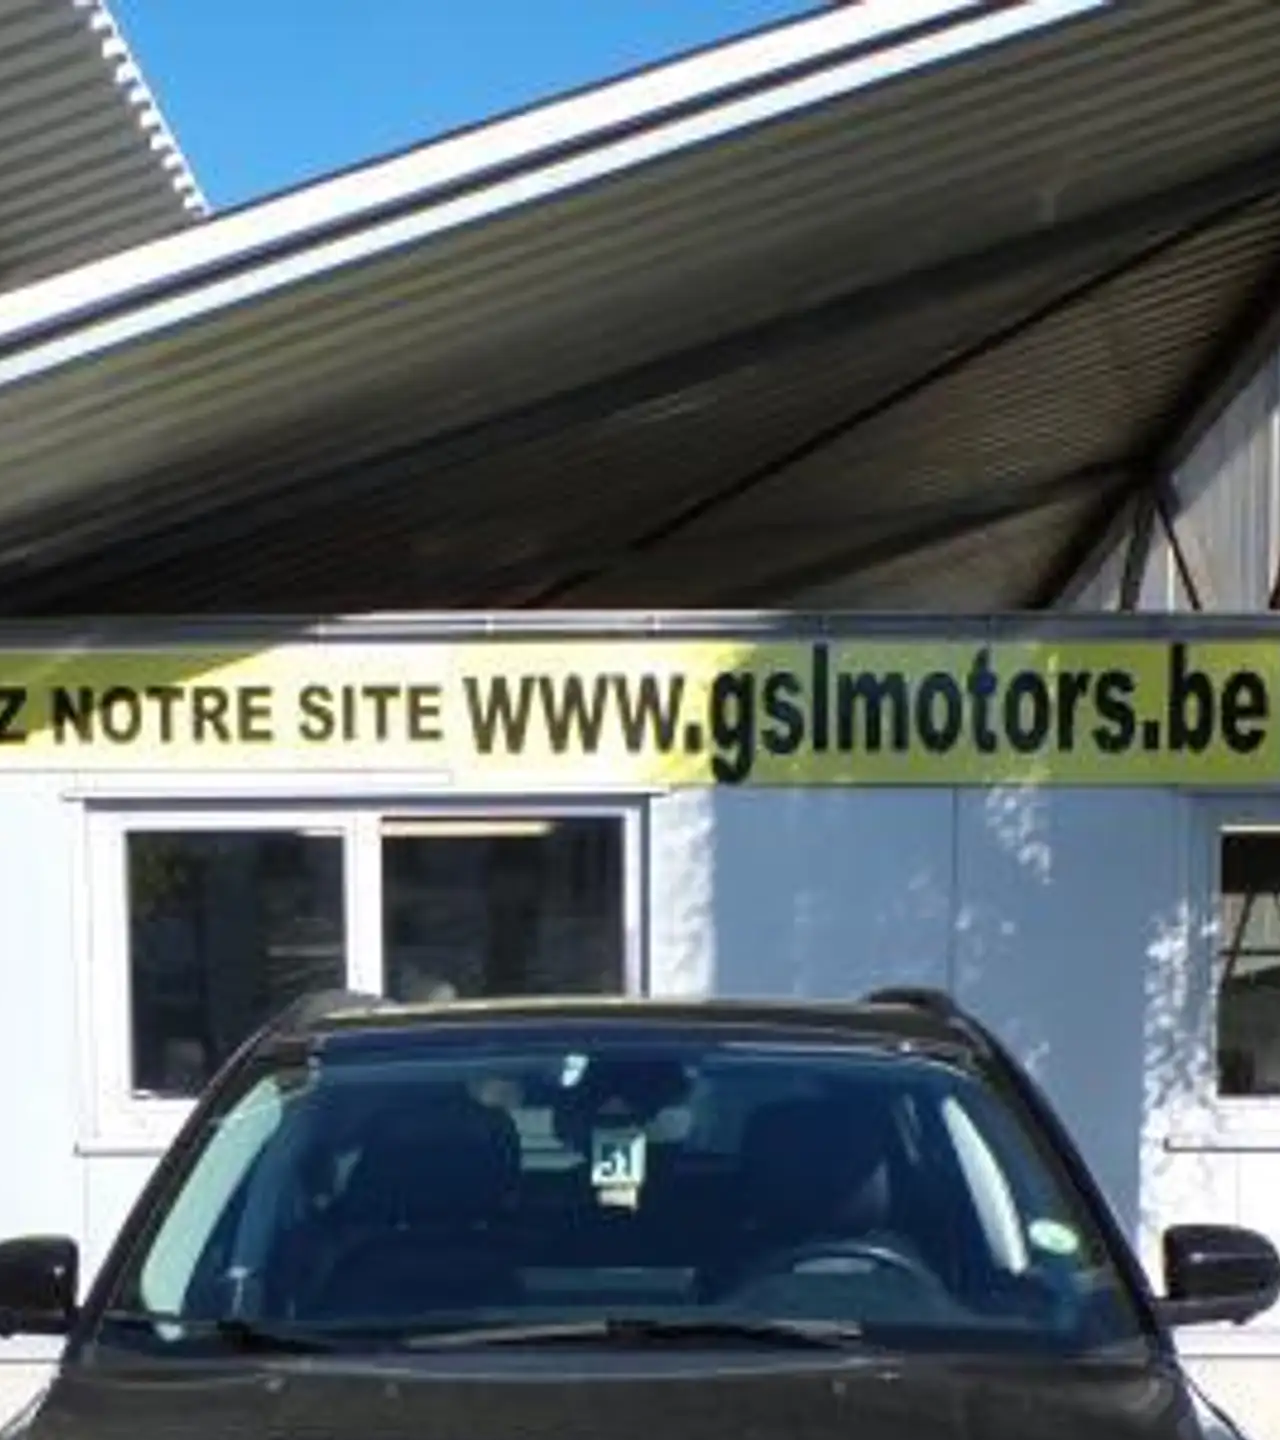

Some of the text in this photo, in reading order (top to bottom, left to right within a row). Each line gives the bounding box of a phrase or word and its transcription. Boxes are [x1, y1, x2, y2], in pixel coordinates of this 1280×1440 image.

[53, 686, 273, 742] NOTRE
[298, 685, 443, 742] SITE
[464, 642, 1270, 783] www.gslmotors.be
